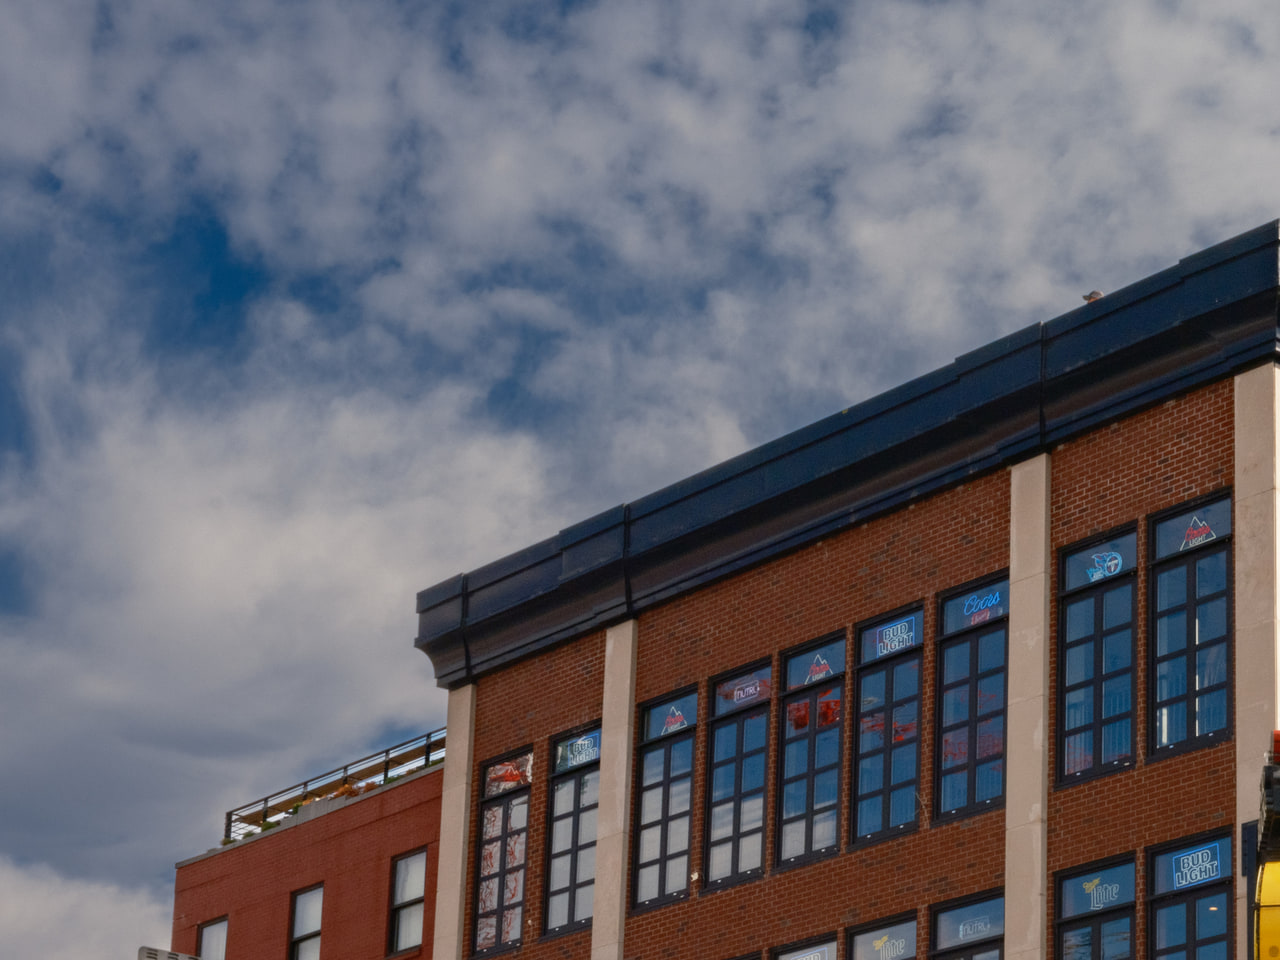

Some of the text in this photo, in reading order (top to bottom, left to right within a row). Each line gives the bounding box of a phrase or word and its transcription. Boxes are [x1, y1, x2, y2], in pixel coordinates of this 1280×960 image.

[1188, 534, 1207, 546] LIGHT
[963, 591, 1001, 616] Coors
[883, 622, 909, 642] BUD
[879, 632, 913, 656] LIGHT
[574, 737, 595, 754] BUD
[570, 747, 598, 767] LIGHT
[1181, 850, 1211, 871] BUD
[1176, 861, 1218, 888] LIGHT
[1090, 883, 1120, 910] Lite
